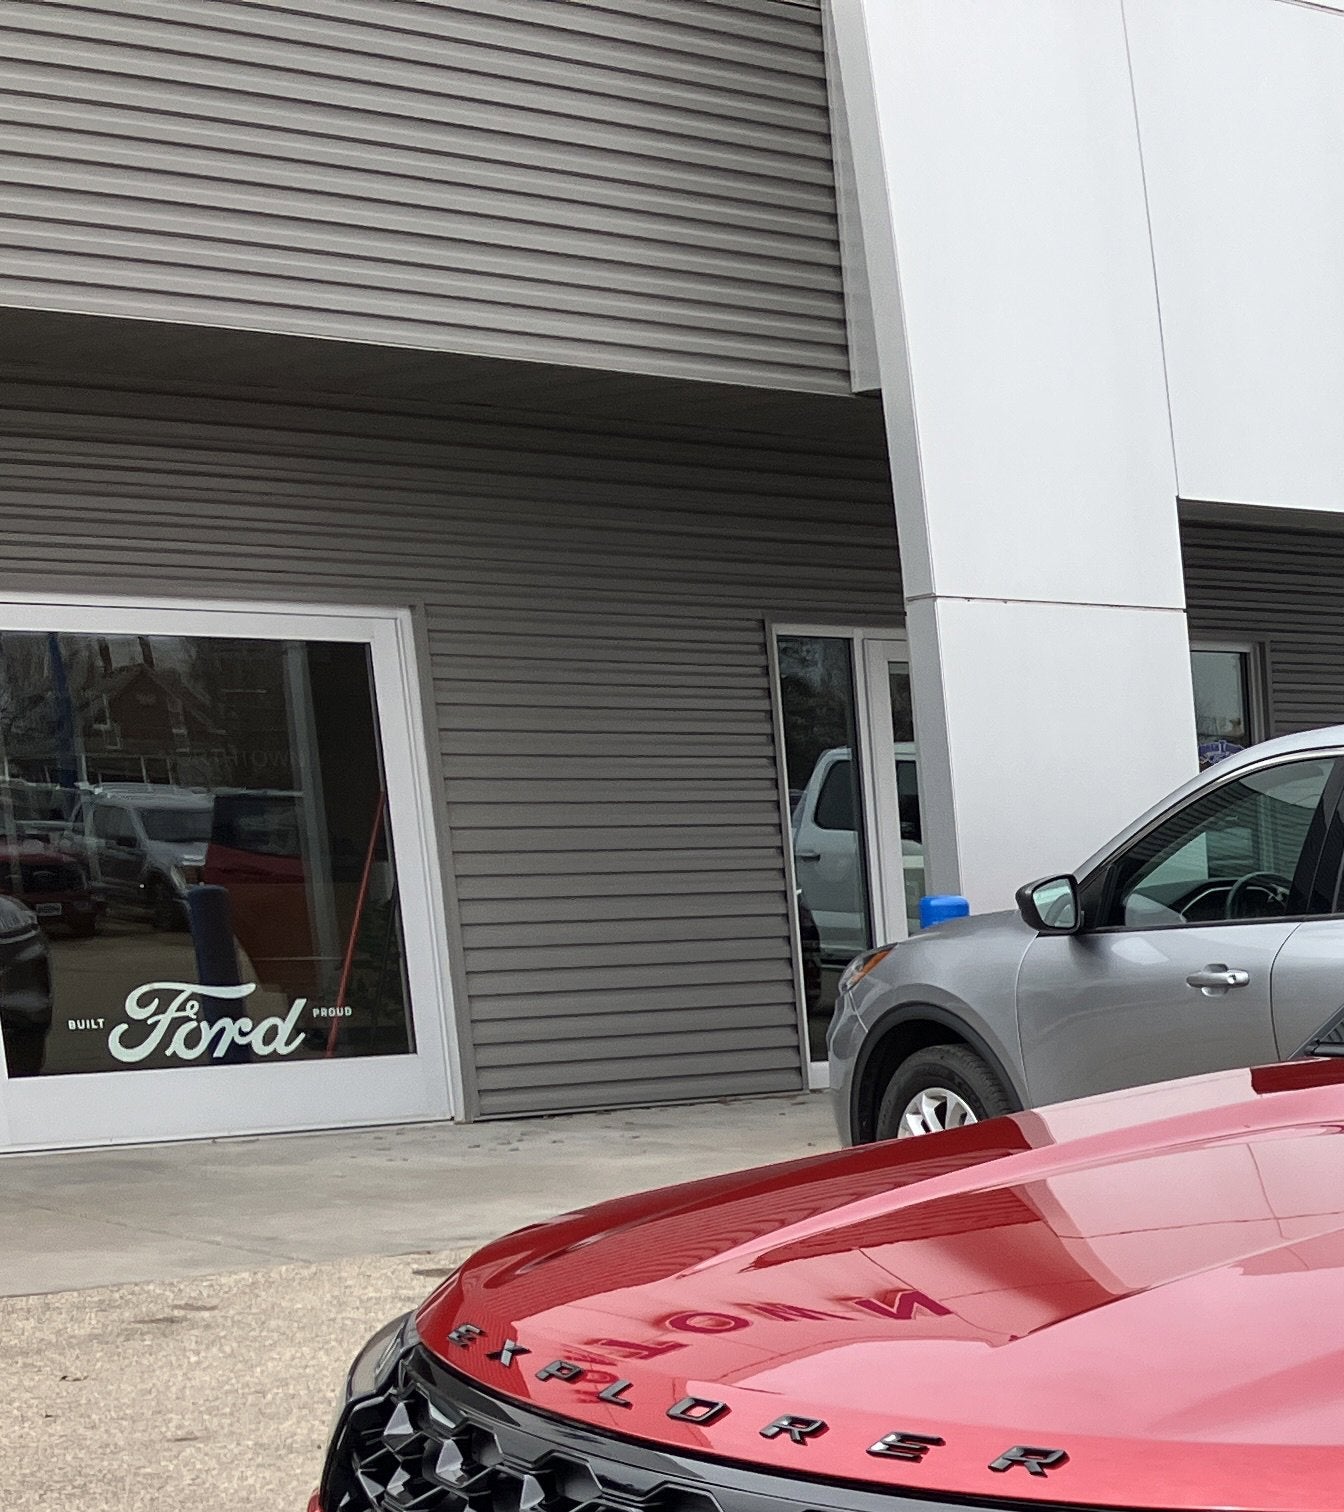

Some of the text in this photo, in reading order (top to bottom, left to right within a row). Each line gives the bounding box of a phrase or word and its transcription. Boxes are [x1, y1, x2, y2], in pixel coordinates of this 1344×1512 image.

[67, 981, 353, 1062] BUILT Ford PROUD
[445, 1321, 1071, 1477] EXPLORER
